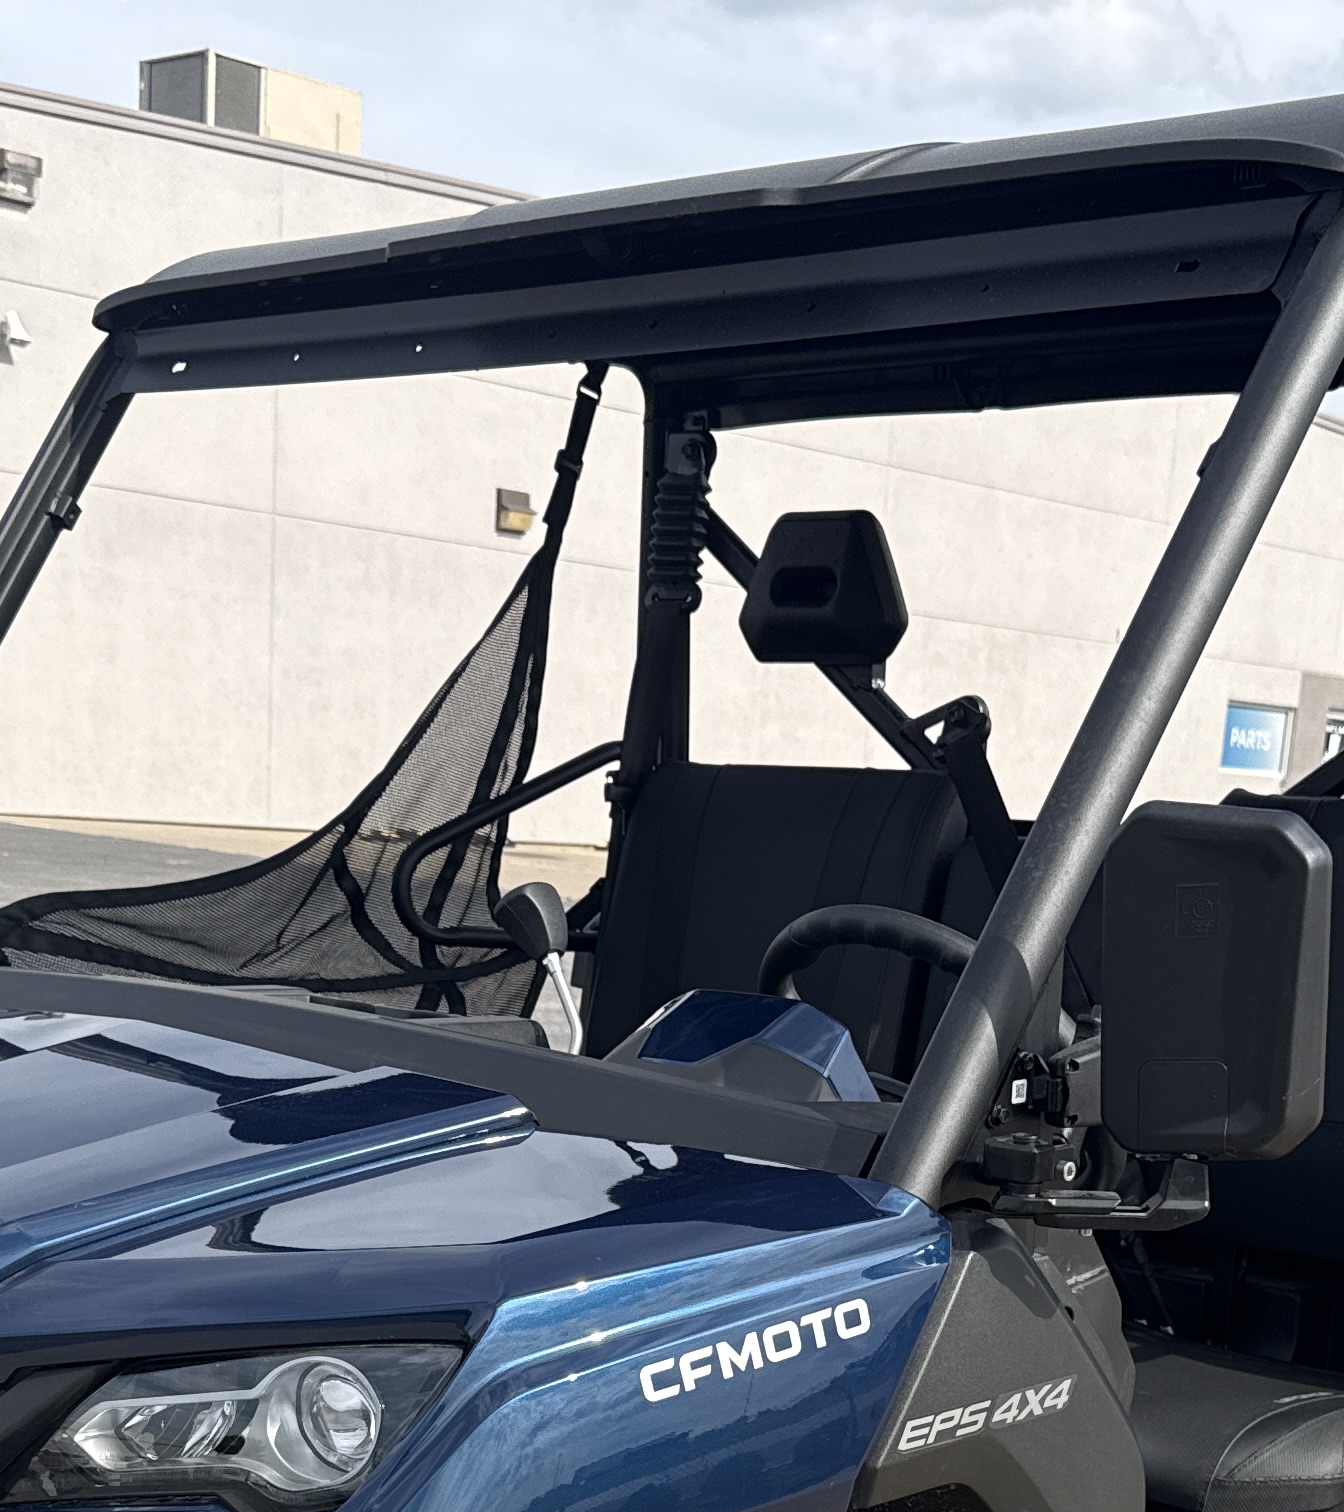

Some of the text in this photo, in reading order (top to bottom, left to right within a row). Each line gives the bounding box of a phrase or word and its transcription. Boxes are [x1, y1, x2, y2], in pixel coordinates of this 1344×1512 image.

[1229, 726, 1272, 752] PARTS
[639, 1297, 872, 1404] CFMOTO
[897, 1378, 1074, 1454] EPS 4X4
